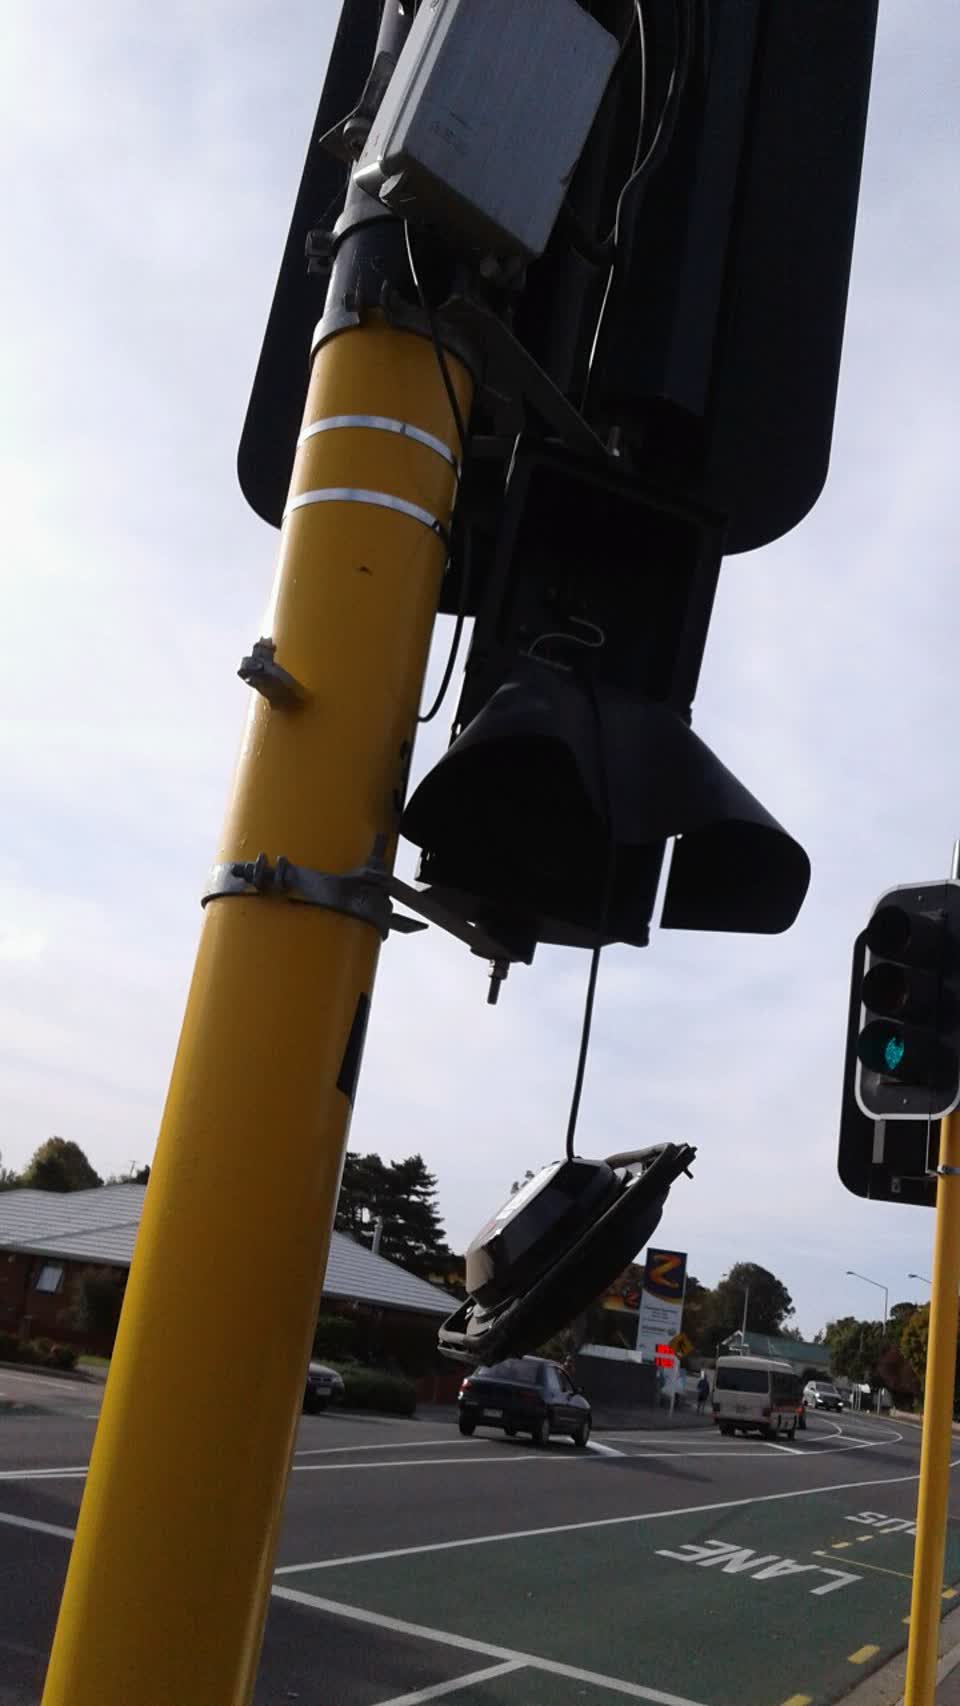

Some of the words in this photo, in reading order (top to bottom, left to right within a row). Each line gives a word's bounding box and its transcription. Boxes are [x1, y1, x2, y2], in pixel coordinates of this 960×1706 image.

[653, 1253, 682, 1289] Z
[844, 1511, 918, 1536] US
[654, 1539, 864, 1596] LANE
